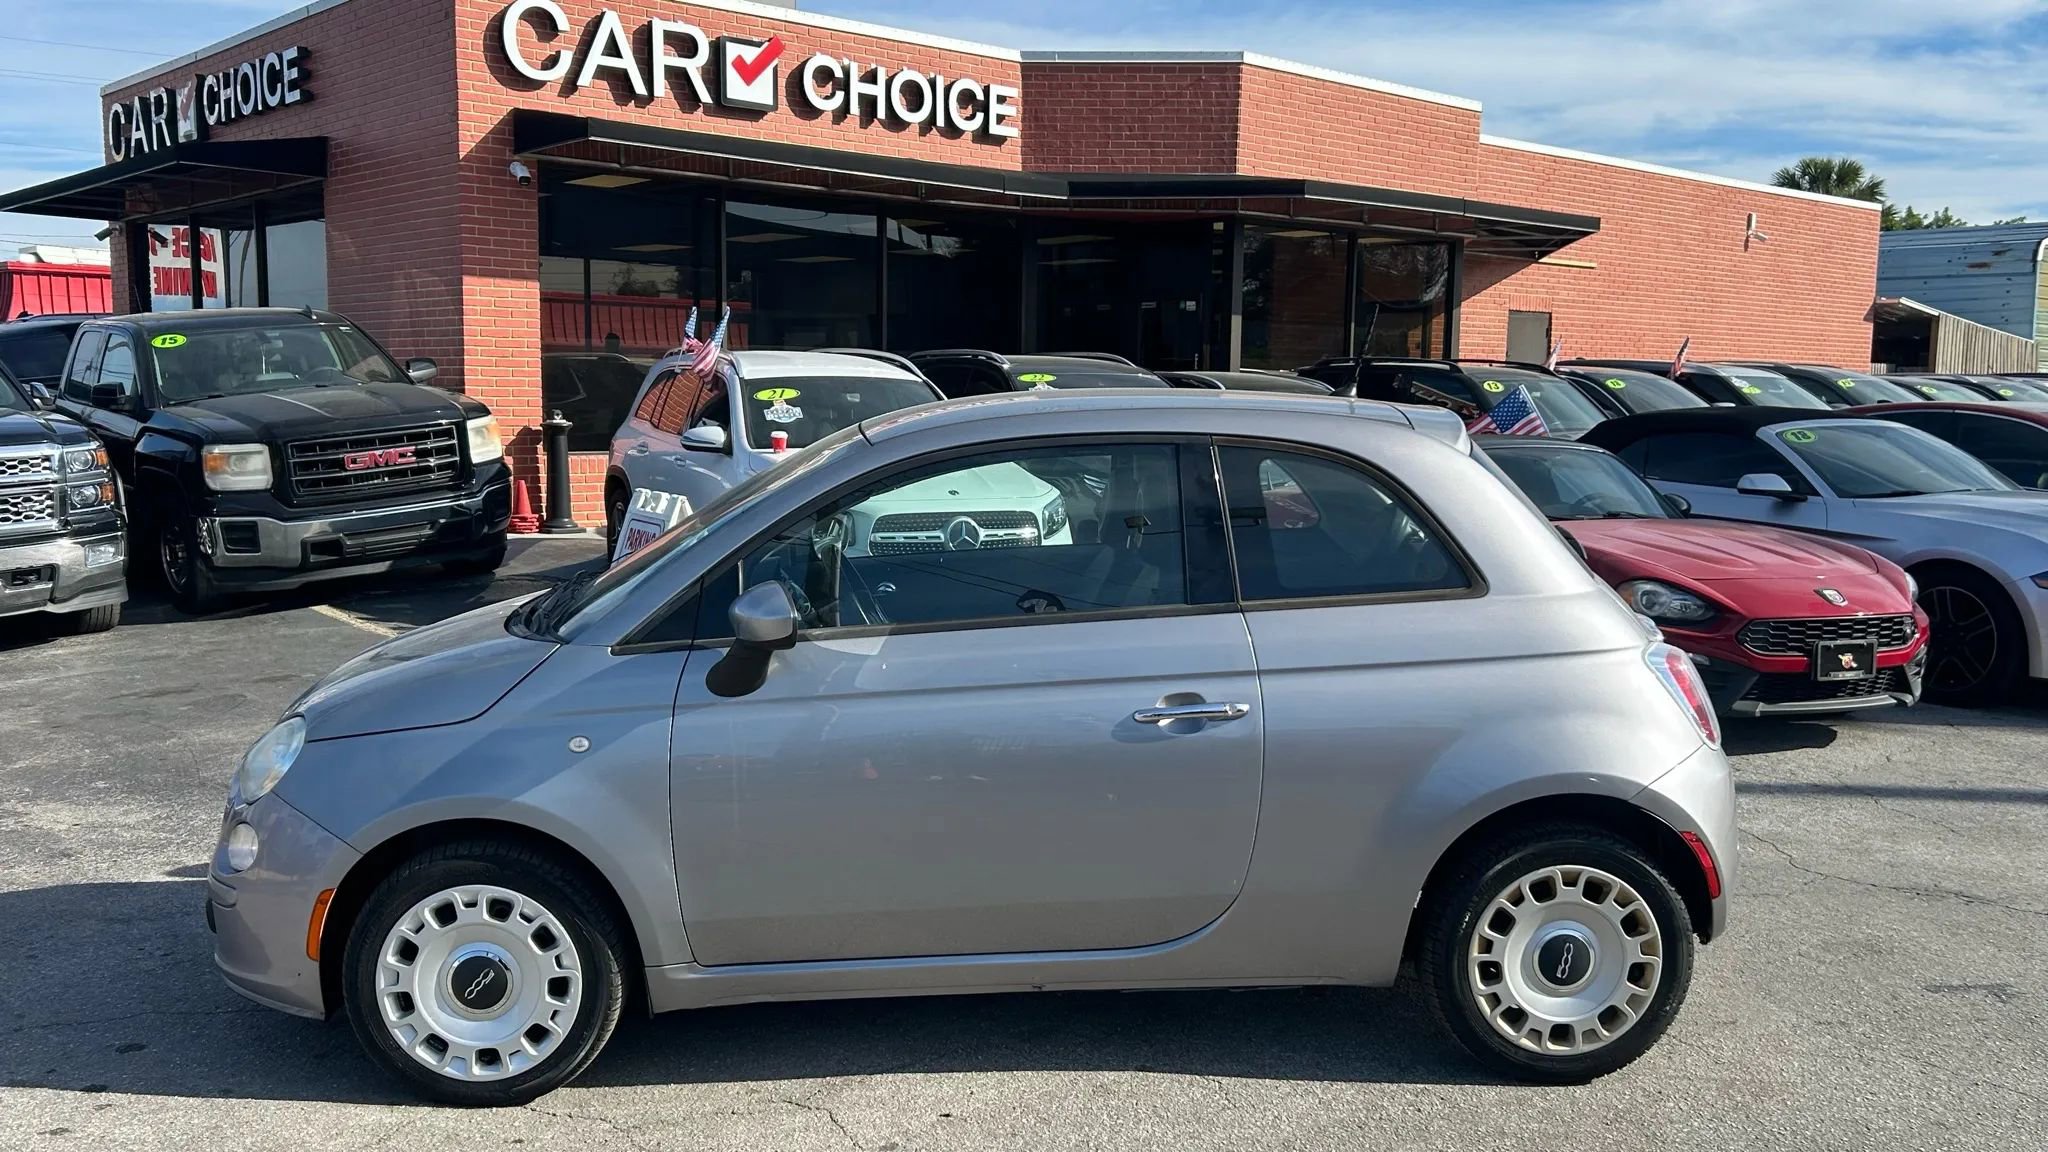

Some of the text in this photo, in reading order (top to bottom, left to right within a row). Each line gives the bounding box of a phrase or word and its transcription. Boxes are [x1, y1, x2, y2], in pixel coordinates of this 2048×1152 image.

[503, 0, 1019, 138] CAR CHOICE
[108, 45, 301, 162] CAR CHOICE
[160, 335, 179, 346] 15
[767, 389, 786, 400] 21
[344, 446, 417, 470] GMC
